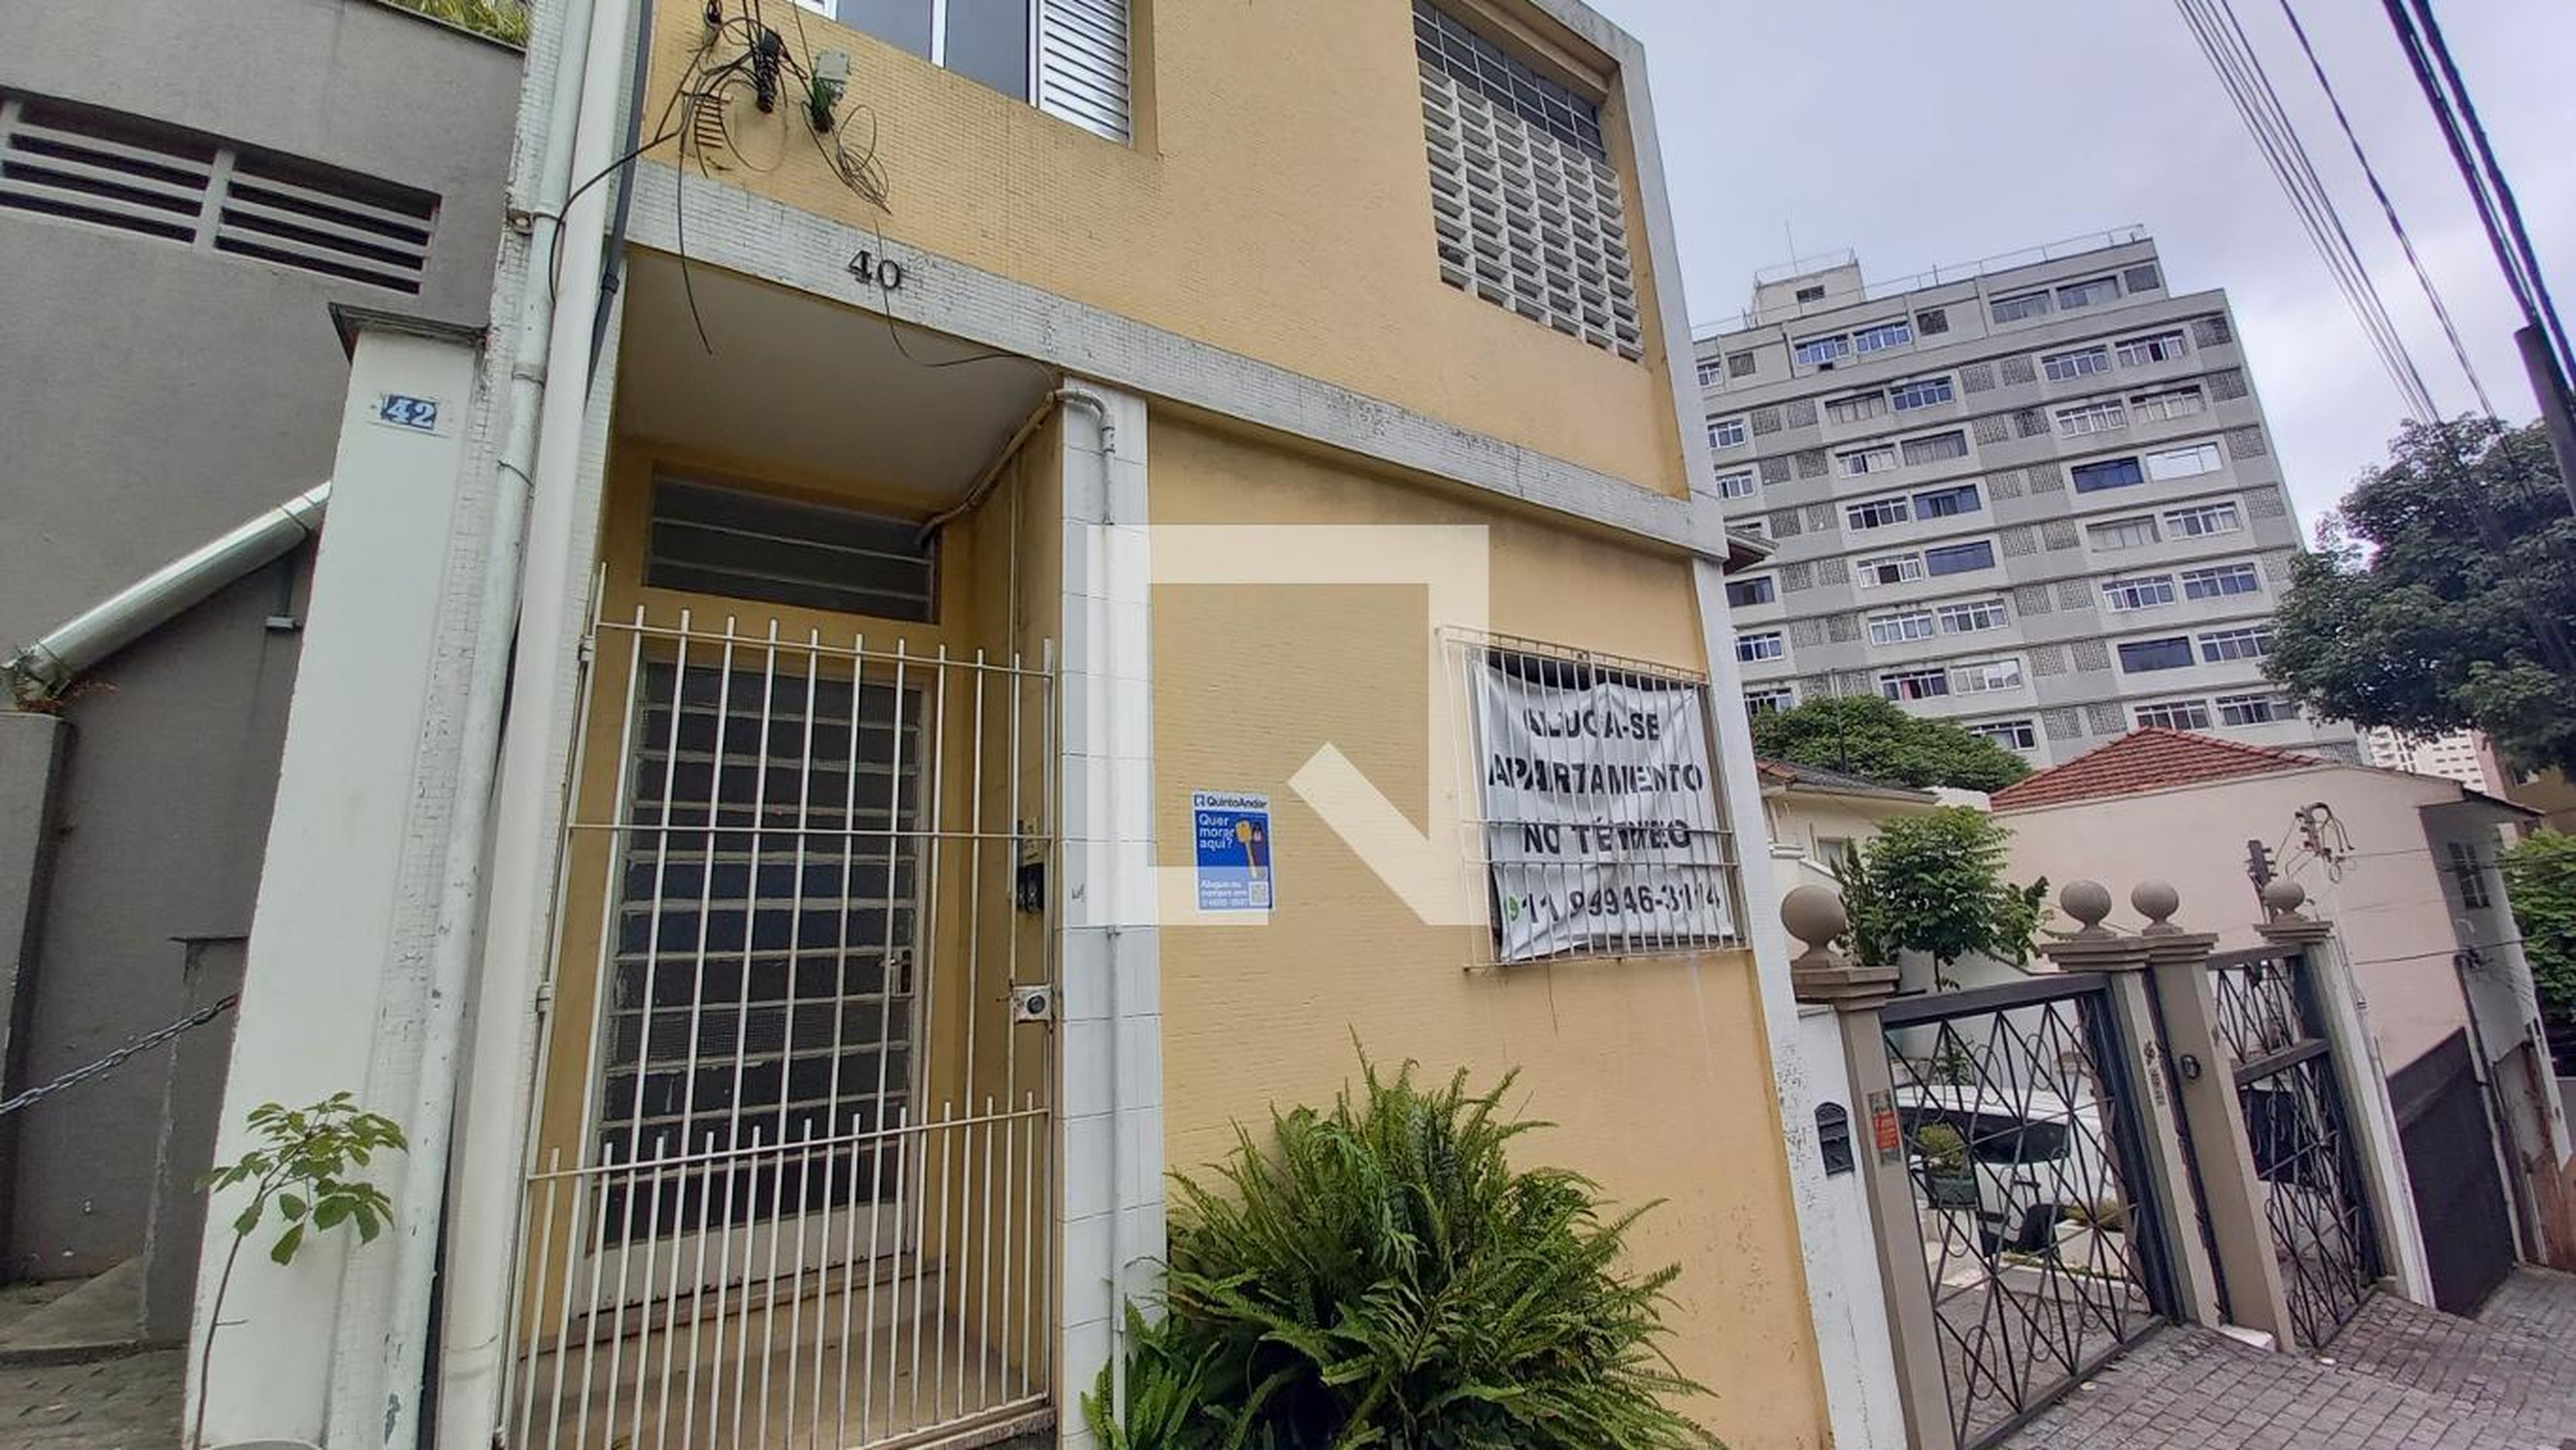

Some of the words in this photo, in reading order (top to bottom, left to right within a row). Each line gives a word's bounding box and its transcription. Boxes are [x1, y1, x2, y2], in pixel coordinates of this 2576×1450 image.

[845, 250, 902, 290] 40
[387, 398, 435, 427] 42
[1488, 753, 1703, 796] APARTAMENTO
[1199, 813, 1230, 827] Quer
[1199, 836, 1234, 852] aqui?
[1524, 822, 1561, 854] NO
